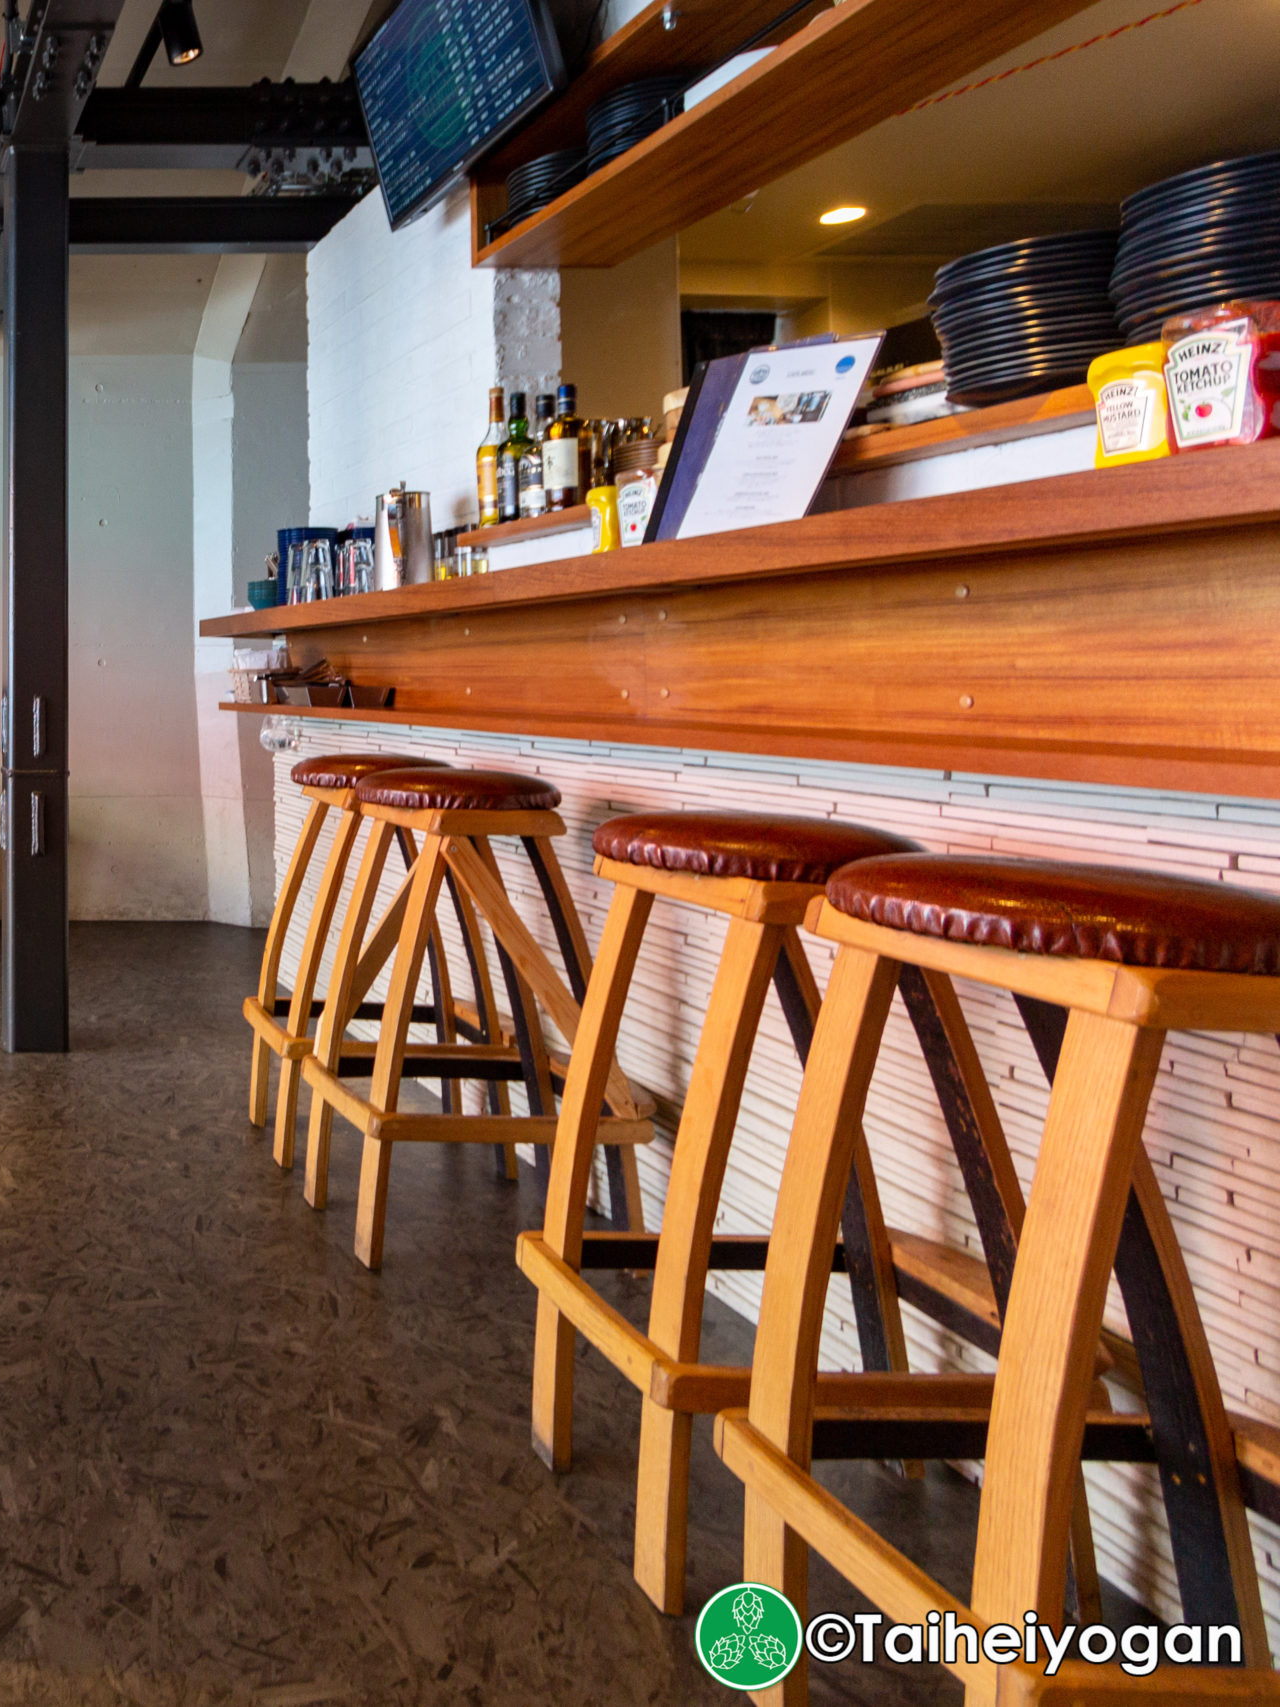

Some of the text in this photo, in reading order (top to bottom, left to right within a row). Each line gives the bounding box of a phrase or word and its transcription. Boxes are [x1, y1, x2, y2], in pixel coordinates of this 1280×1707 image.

[1178, 342, 1222, 362] HEINZ
[1174, 360, 1233, 384] TOMATO
[1177, 374, 1231, 394] KETCHUP
[1105, 386, 1134, 400] HEINZ
[1106, 401, 1134, 412] YELLOW
[1103, 409, 1141, 423] MUSTARD
[623, 500, 647, 509] TOMATO
